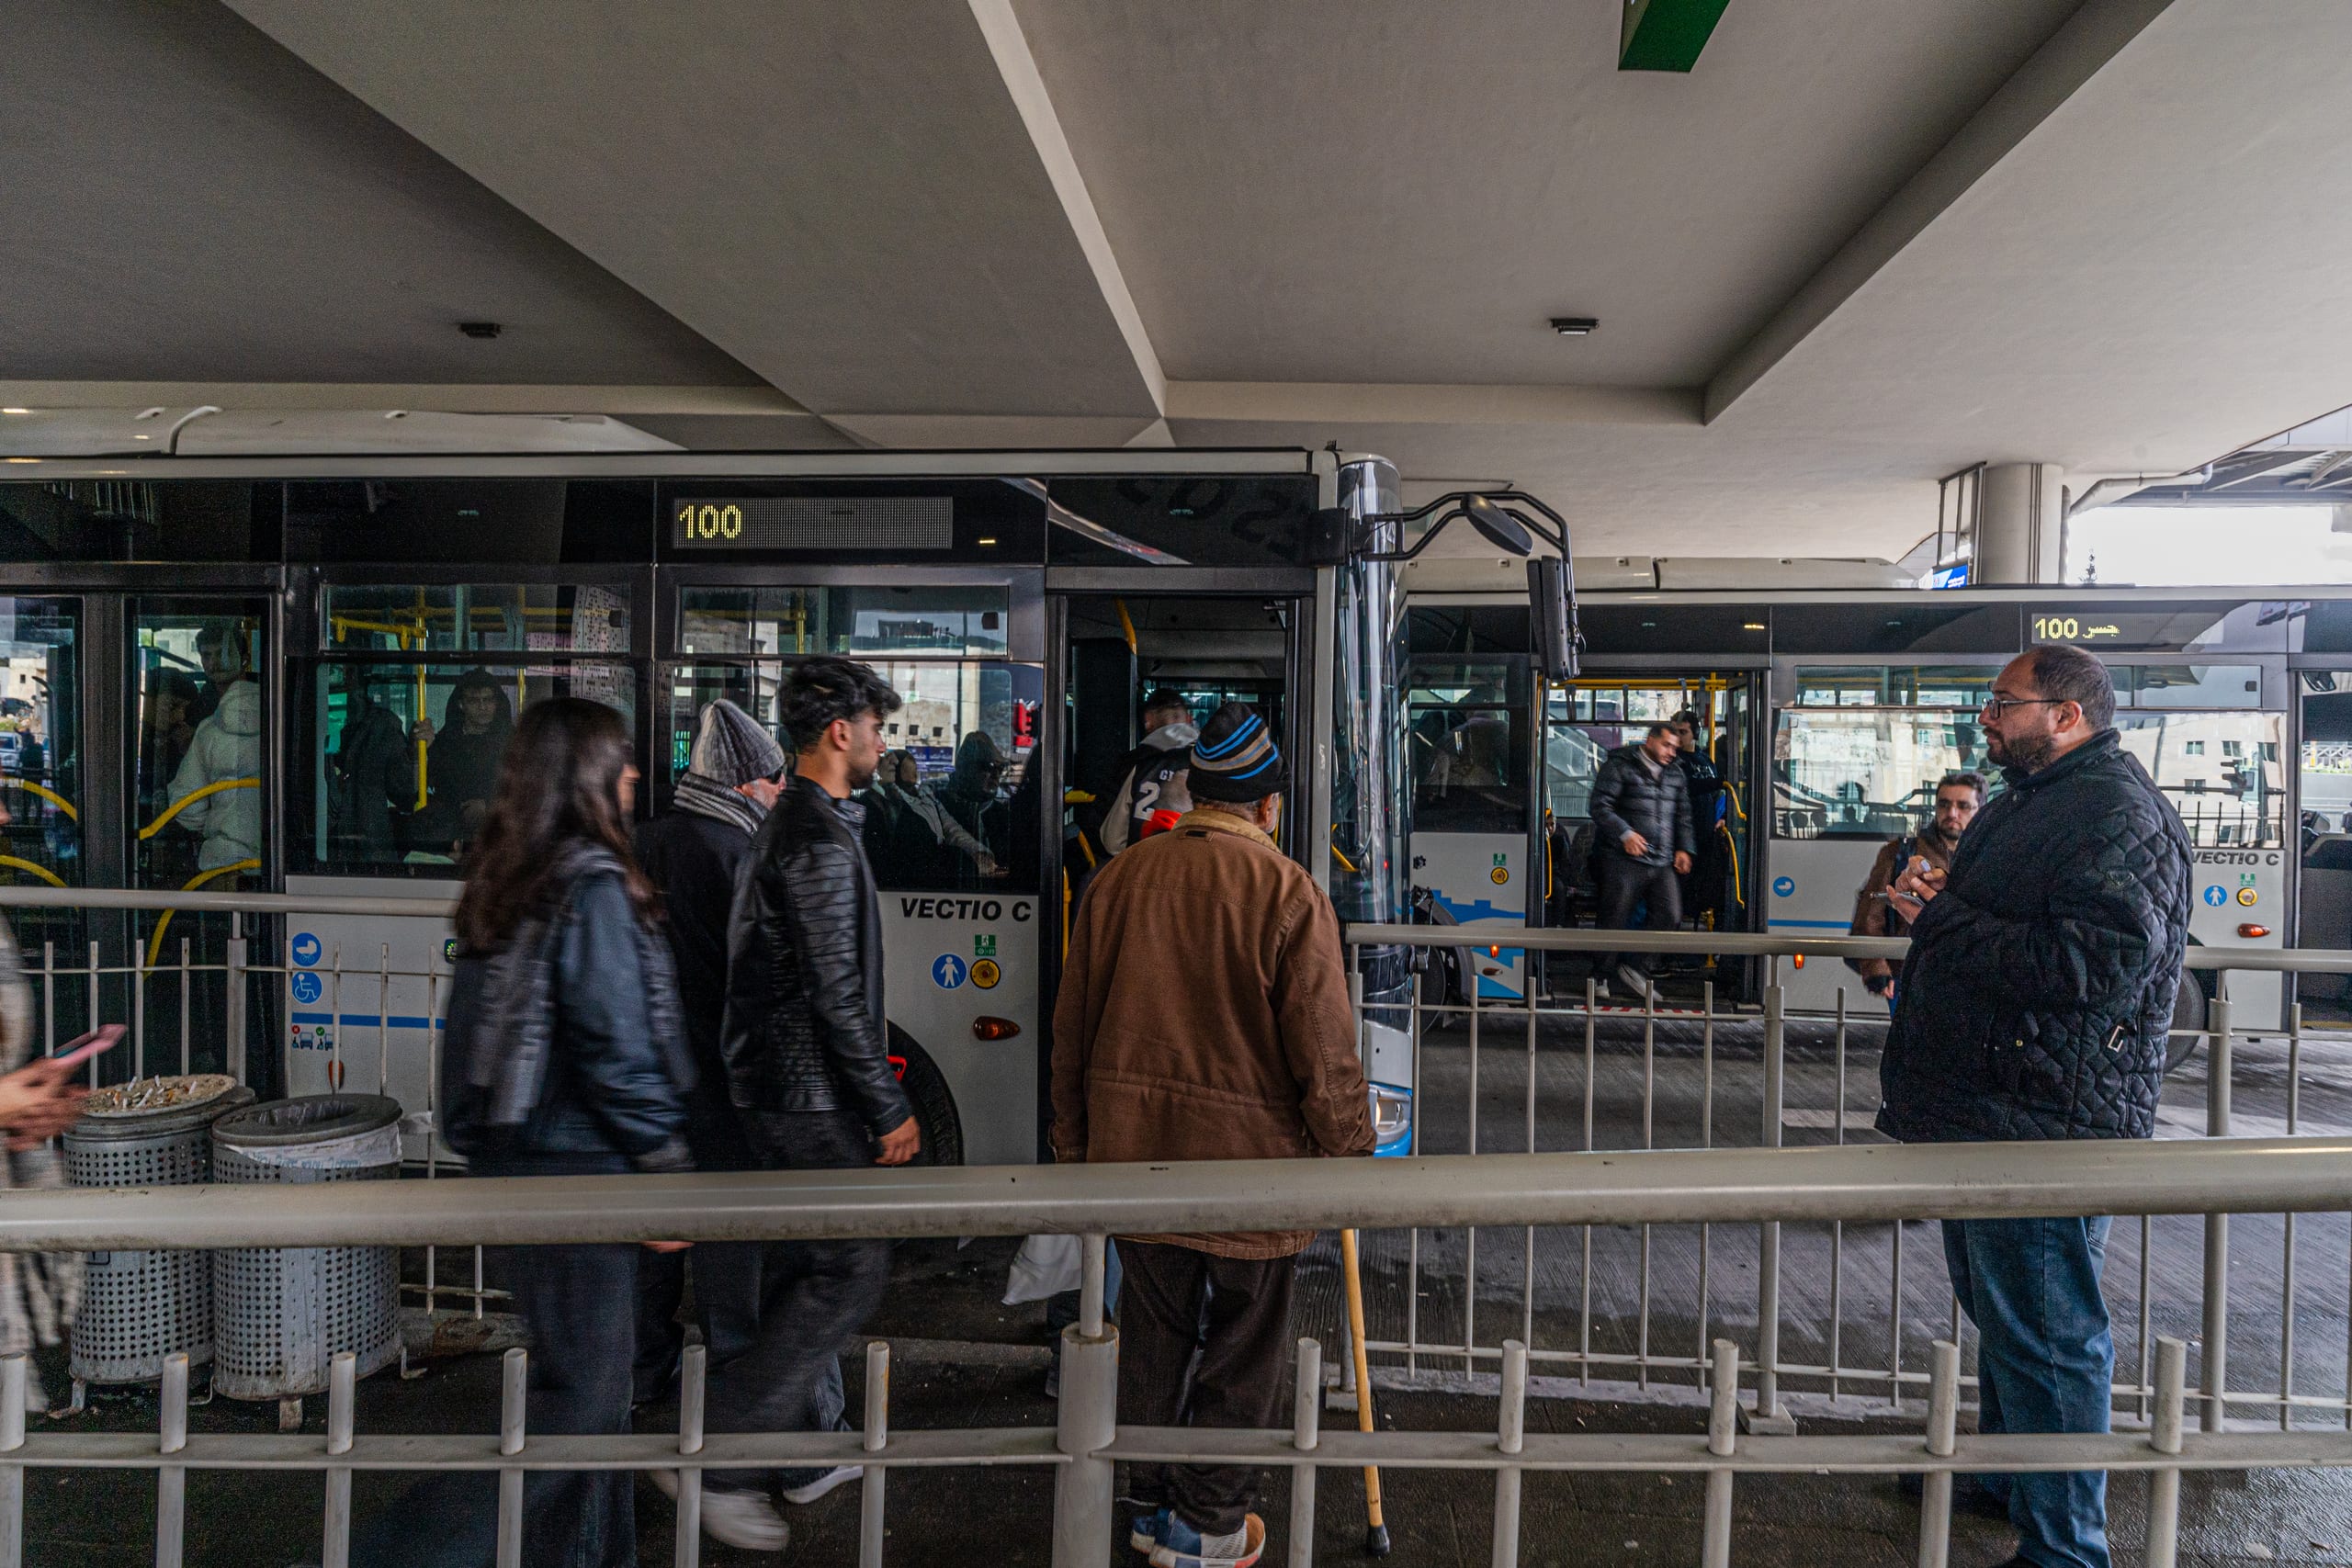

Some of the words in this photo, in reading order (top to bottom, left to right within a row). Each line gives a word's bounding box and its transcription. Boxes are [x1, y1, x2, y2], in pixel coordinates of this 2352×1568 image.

[679, 504, 741, 538] 100
[2035, 617, 2078, 639] 100
[1133, 781, 1161, 821] 2
[2266, 853, 2279, 866] C
[900, 897, 1002, 921] VECTIO
[1012, 901, 1032, 922] C
